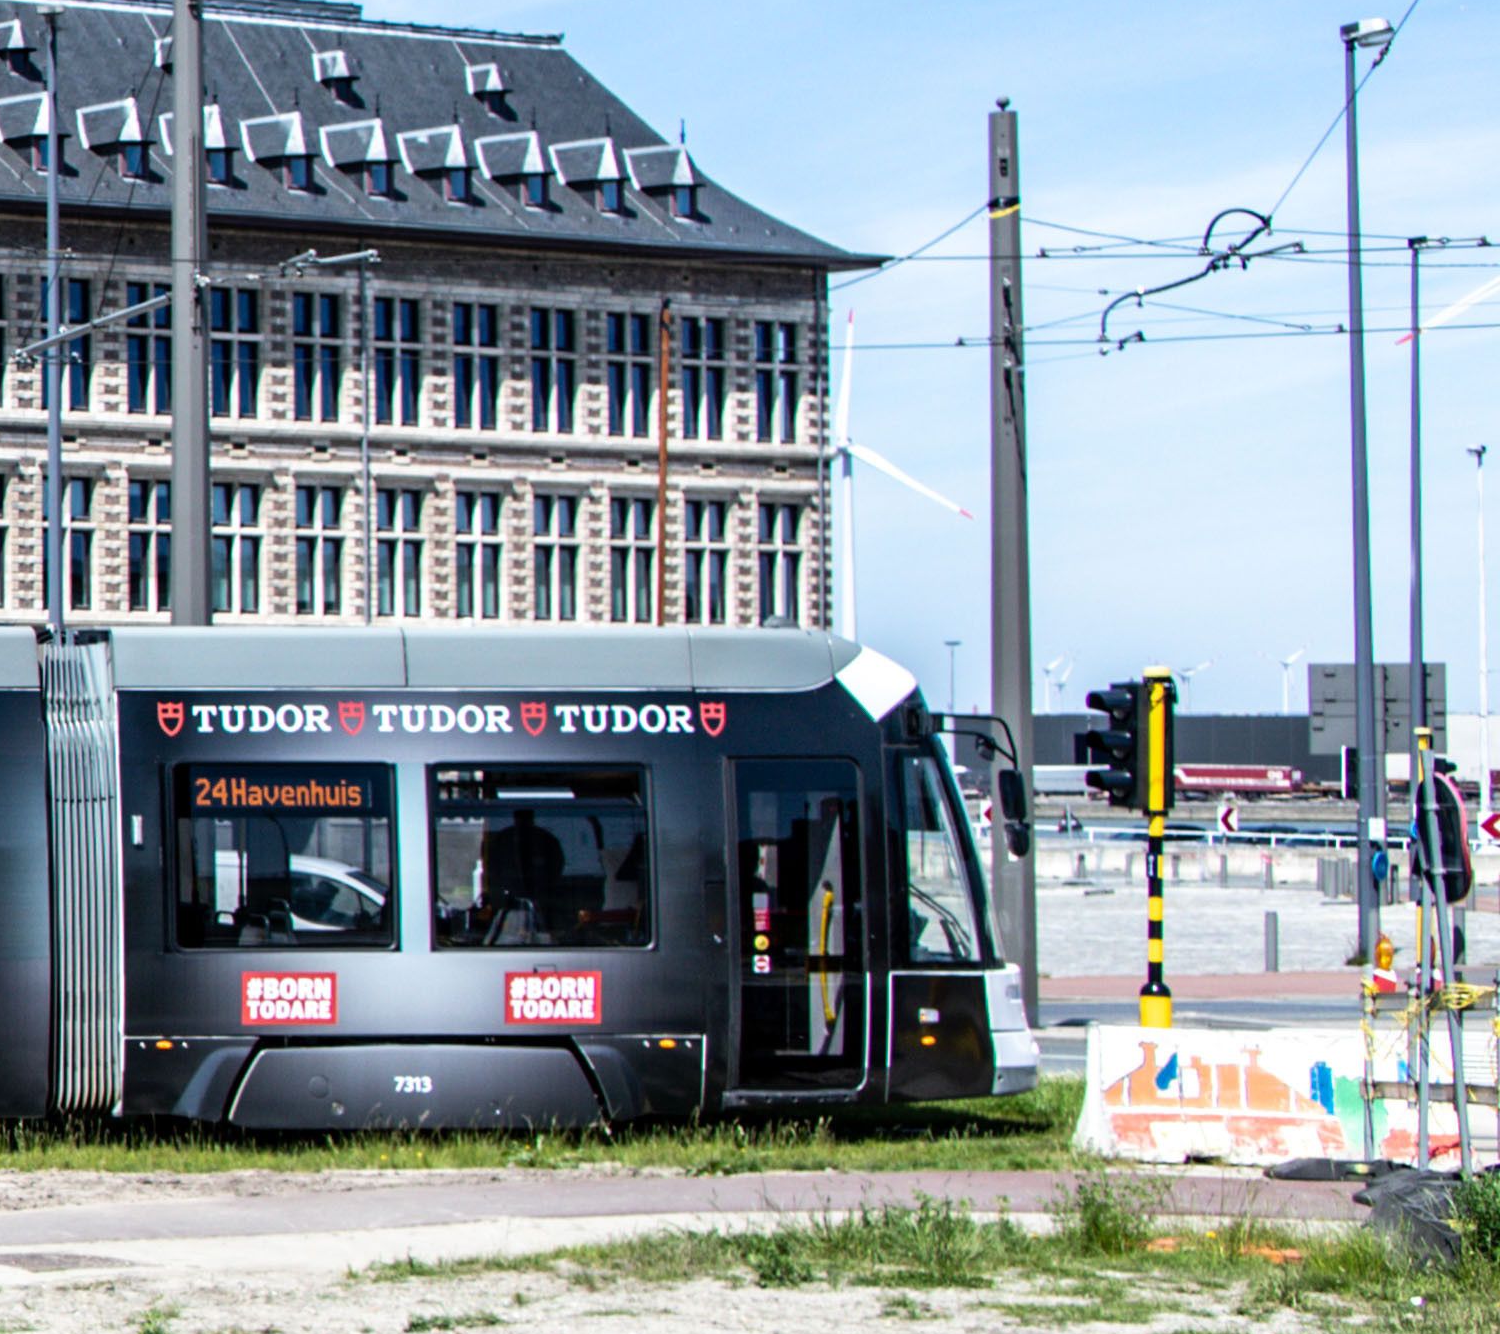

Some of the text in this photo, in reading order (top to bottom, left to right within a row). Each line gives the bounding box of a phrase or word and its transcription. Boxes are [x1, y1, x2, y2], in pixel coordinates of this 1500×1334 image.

[192, 704, 696, 733] TUDOR TUDOR TUDOR
[195, 777, 363, 807] 24 Havenhuis
[246, 977, 332, 1000] #BORN
[509, 977, 595, 1000] #BORN
[246, 999, 332, 1019] TODARE
[510, 998, 595, 1019] TODARE
[393, 1076, 433, 1093] 7313
